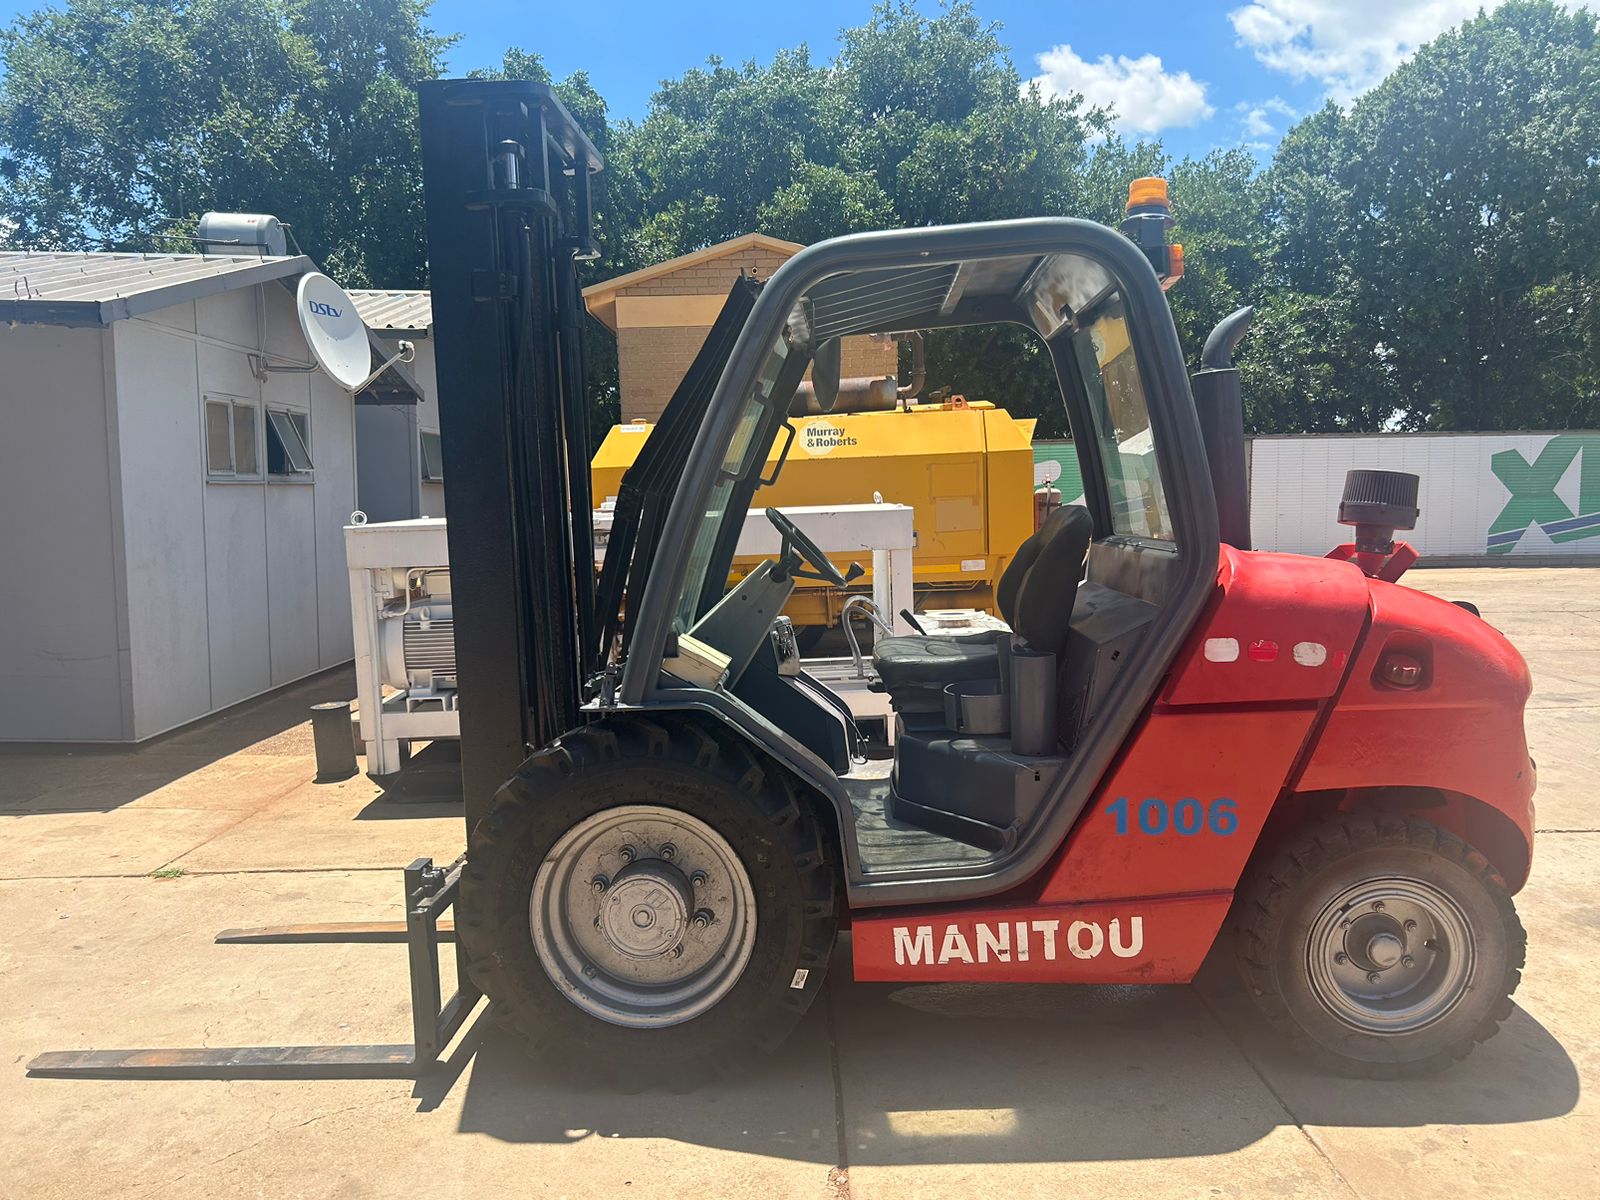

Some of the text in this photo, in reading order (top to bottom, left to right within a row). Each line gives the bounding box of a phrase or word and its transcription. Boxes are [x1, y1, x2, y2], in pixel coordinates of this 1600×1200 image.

[806, 428, 845, 438] Murray
[1105, 797, 1239, 835] 1006
[893, 917, 1144, 965] MANITOU
